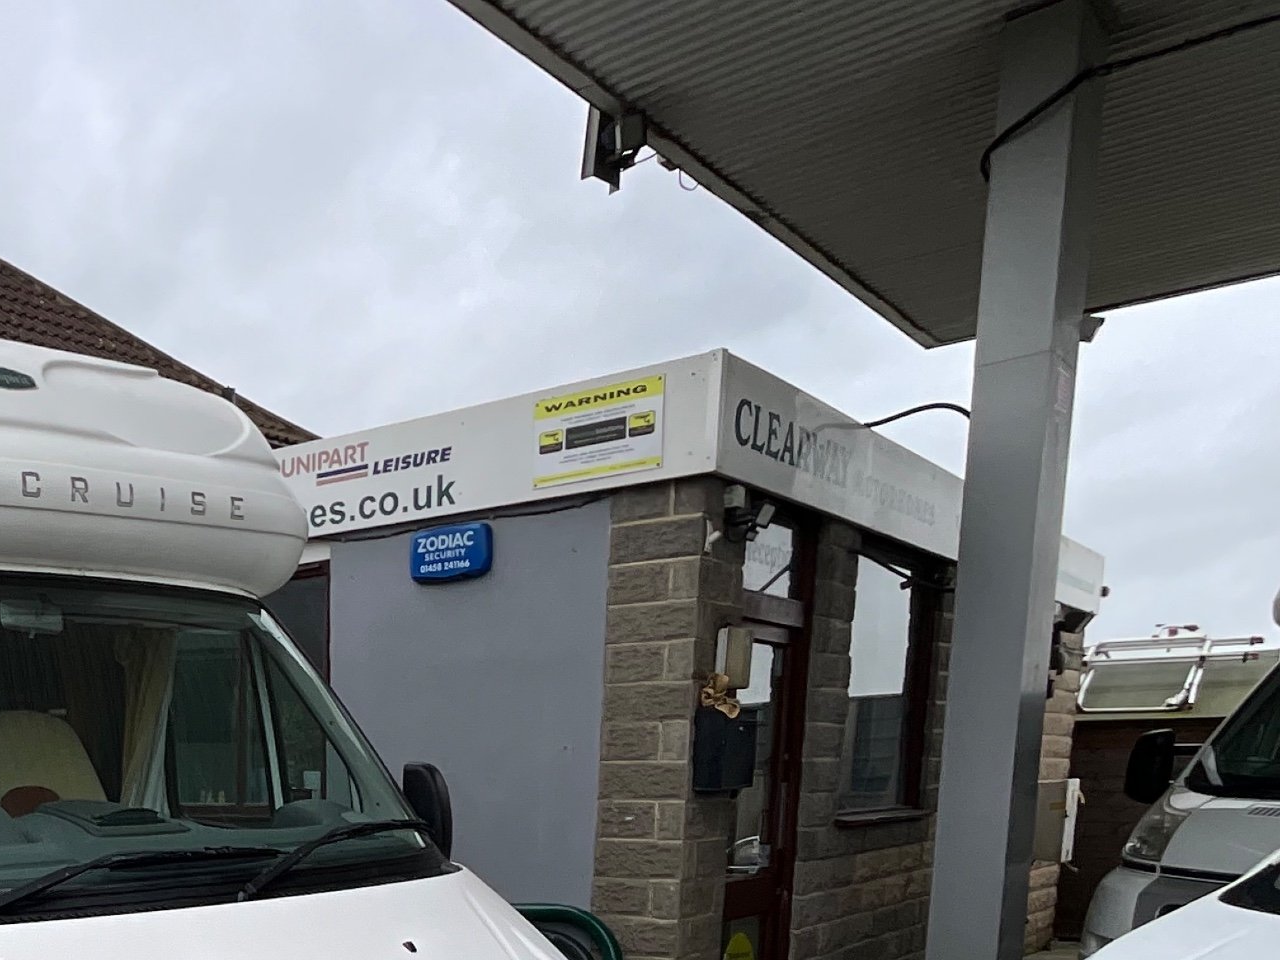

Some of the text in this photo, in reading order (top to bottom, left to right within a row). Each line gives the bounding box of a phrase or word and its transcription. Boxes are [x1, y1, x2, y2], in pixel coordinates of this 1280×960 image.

[544, 384, 648, 413] WARNING
[281, 441, 453, 478] UNIPART LEISURE
[417, 530, 474, 554] ZODIAC
[424, 547, 466, 562] SECURITY
